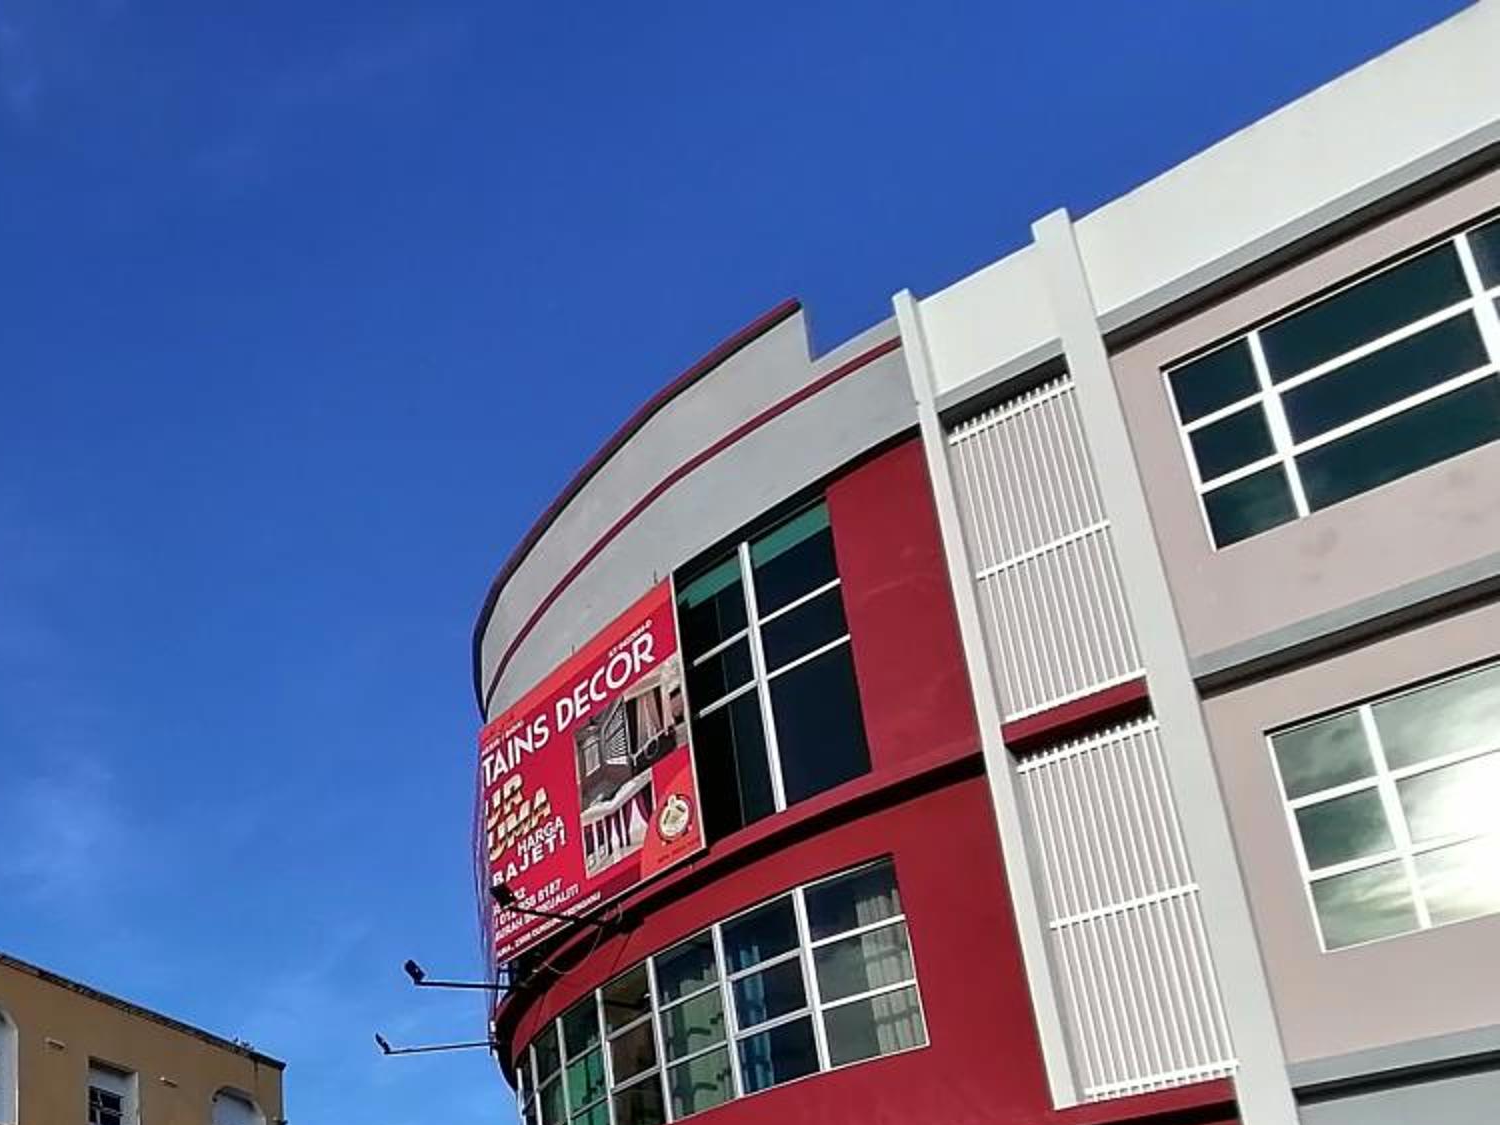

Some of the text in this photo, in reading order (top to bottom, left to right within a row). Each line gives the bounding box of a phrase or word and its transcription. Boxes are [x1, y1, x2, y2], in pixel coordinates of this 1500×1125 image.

[555, 632, 656, 732] DECOR
[492, 829, 566, 889] BAJET!
[517, 815, 564, 857] HARGA
